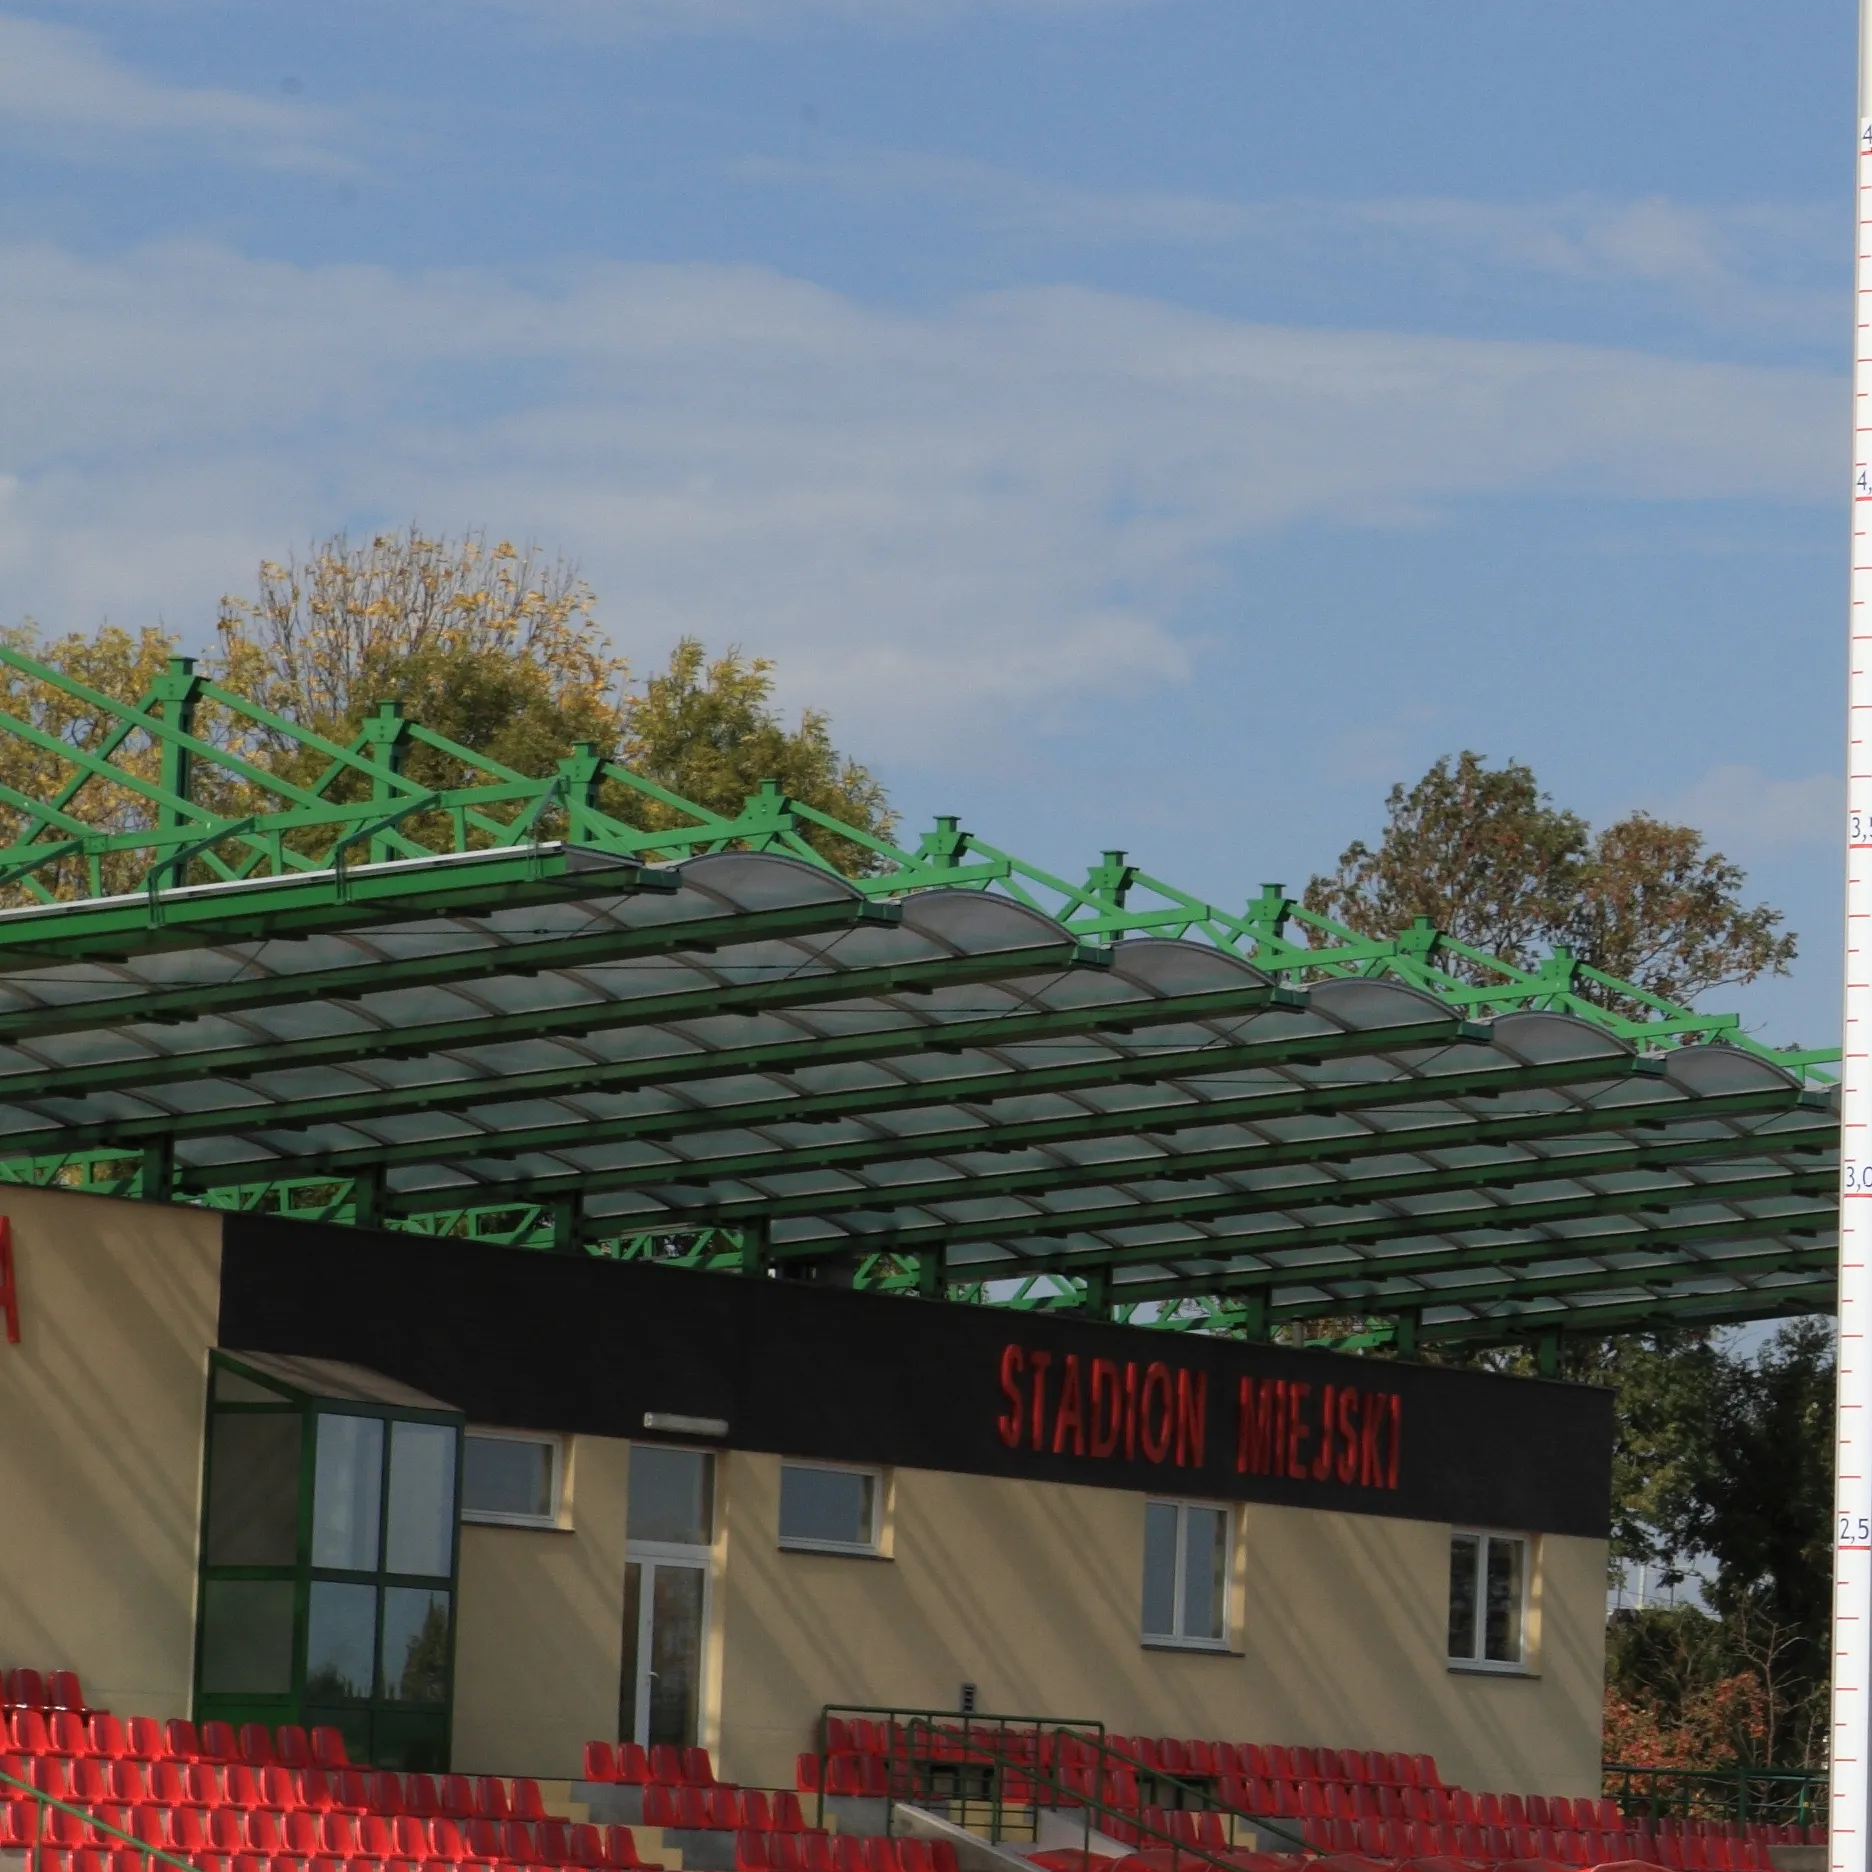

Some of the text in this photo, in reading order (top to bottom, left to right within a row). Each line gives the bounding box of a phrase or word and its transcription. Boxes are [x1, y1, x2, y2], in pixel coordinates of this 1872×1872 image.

[997, 1343, 1402, 1490] STADION MIEJSKI
[1840, 1518, 1869, 1544] 2,5
